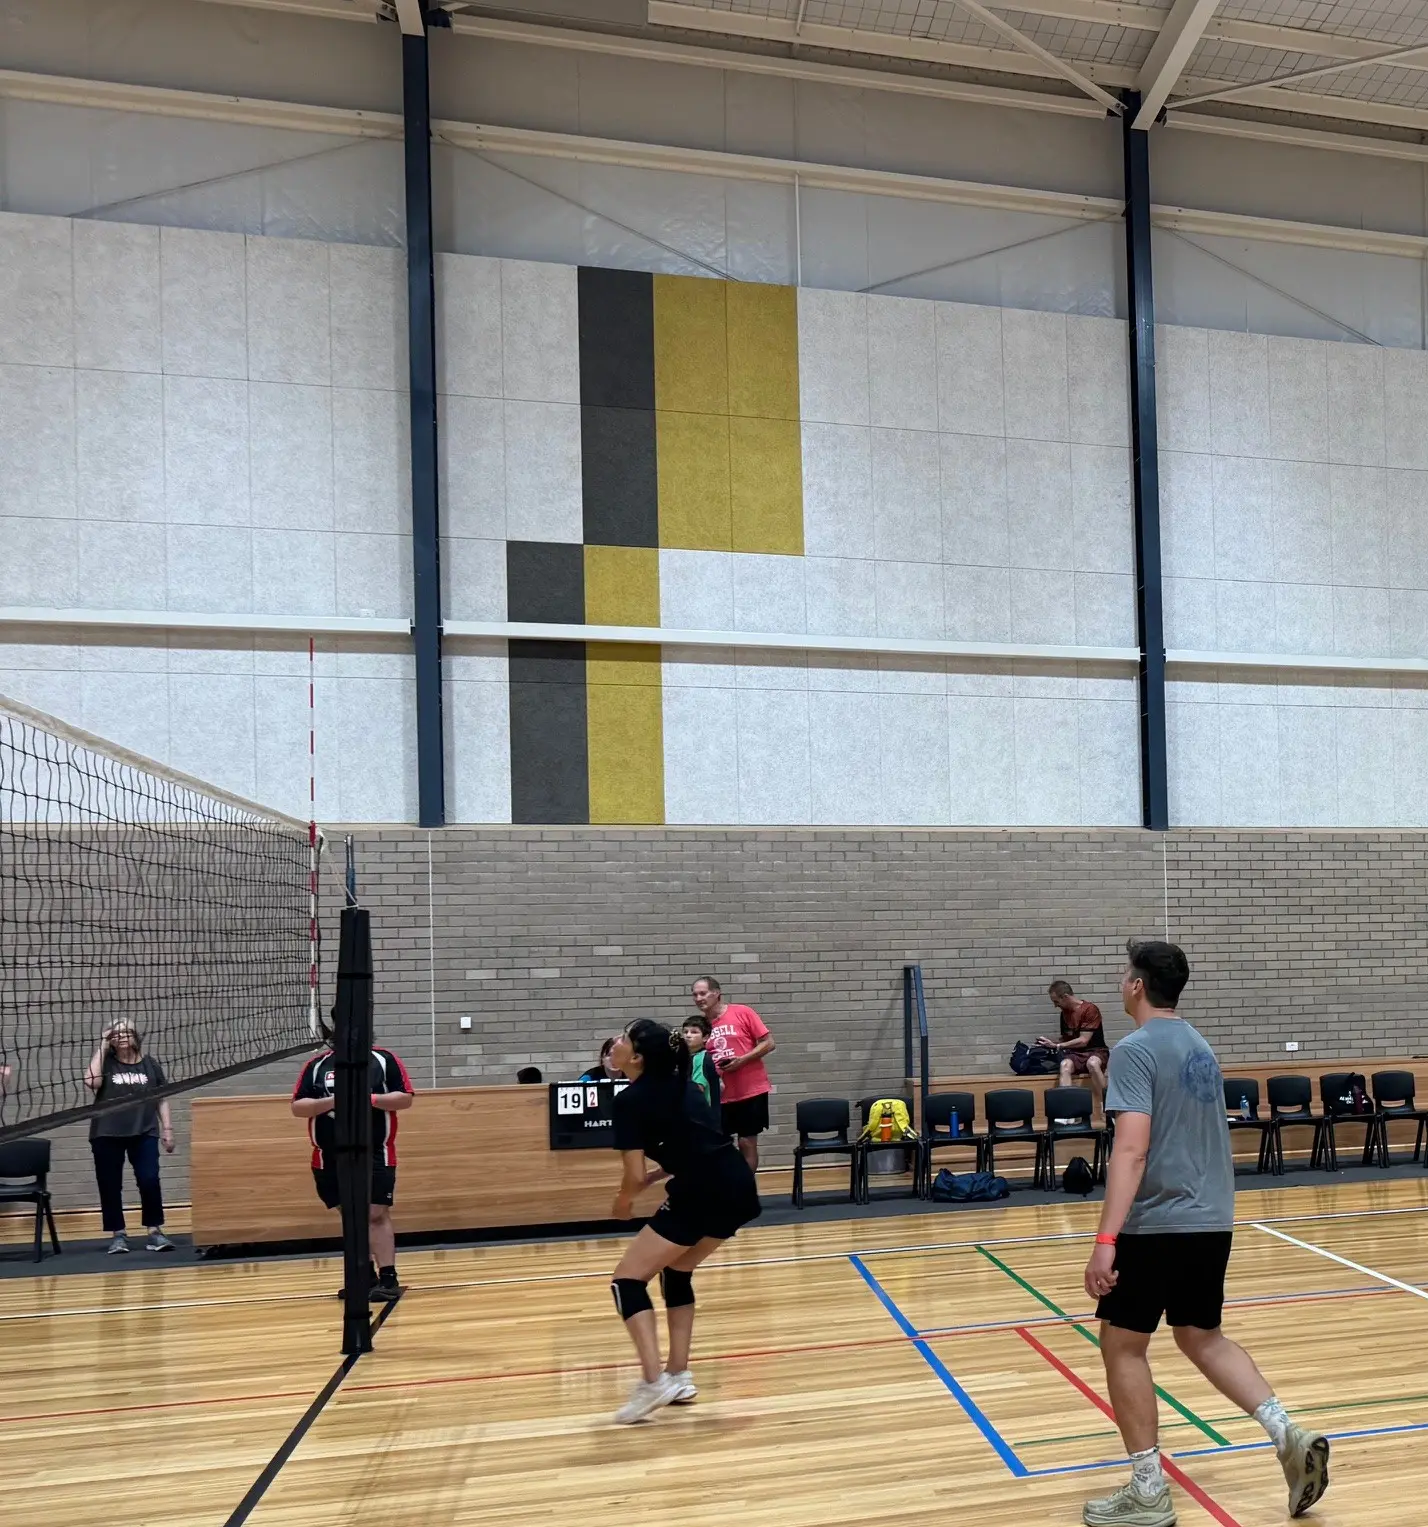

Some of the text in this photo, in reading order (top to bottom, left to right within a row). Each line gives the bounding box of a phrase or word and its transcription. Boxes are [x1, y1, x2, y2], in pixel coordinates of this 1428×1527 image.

[560, 1093, 580, 1109] 19
[589, 1092, 596, 1106] 2
[584, 1119, 612, 1127] HART
